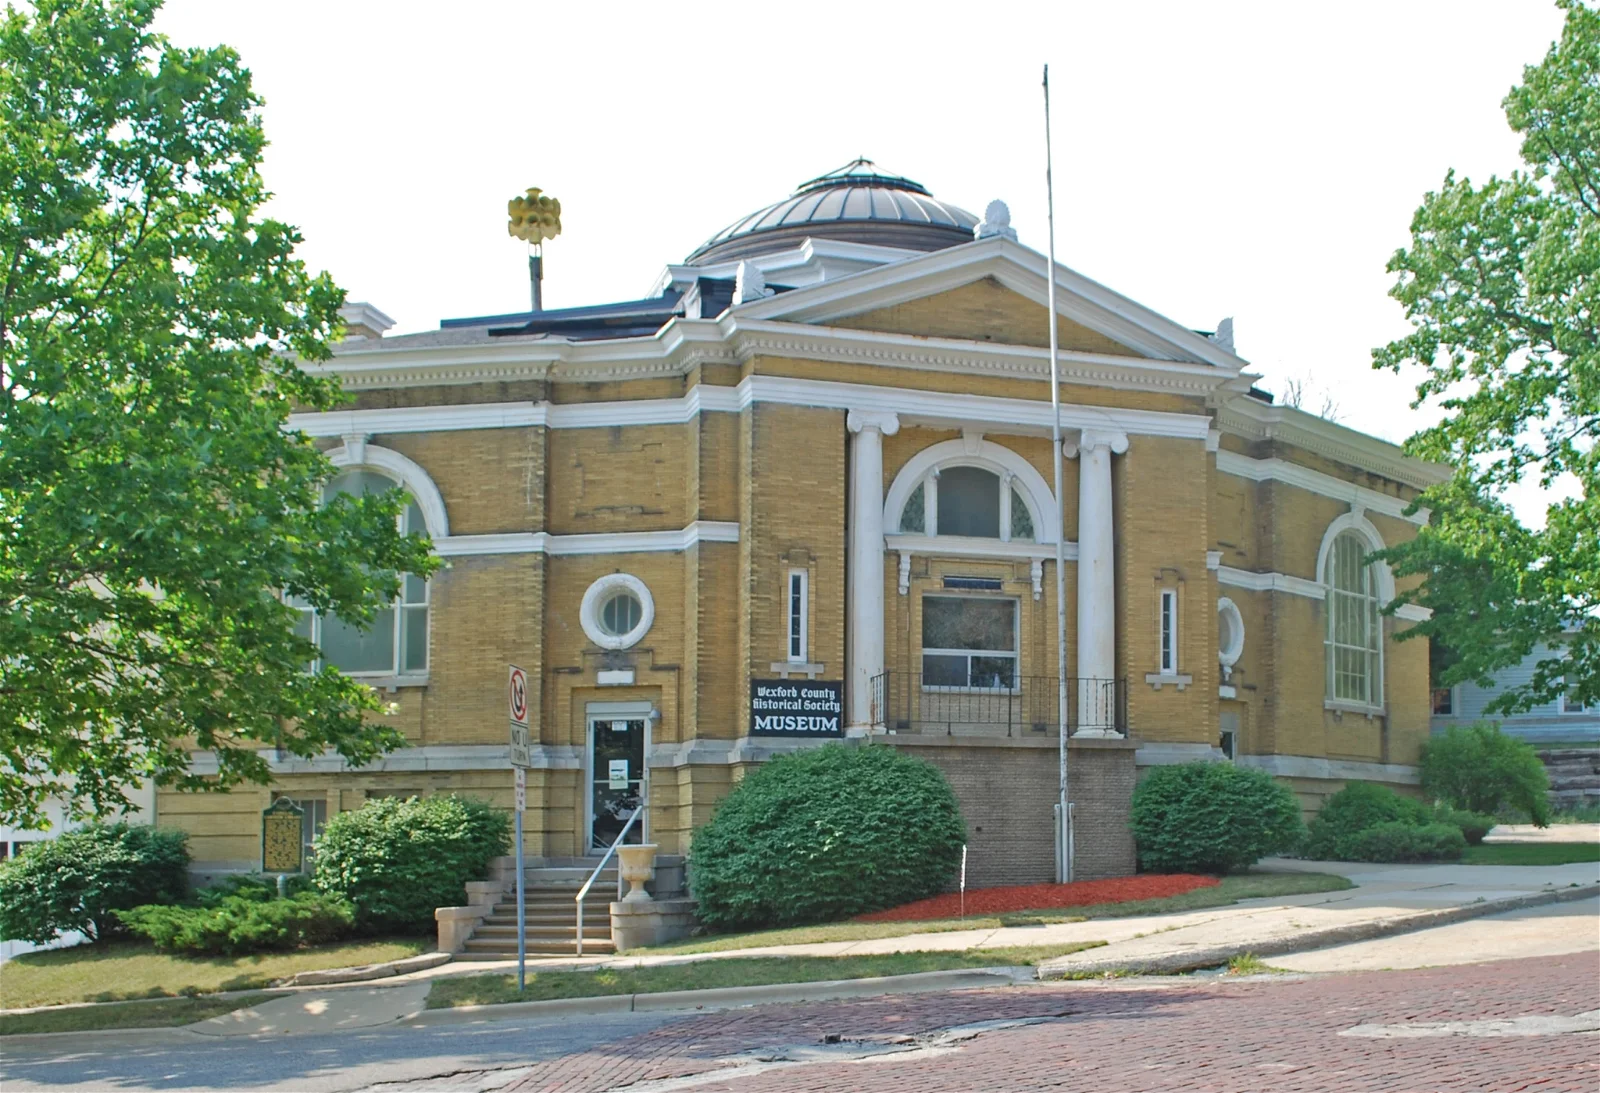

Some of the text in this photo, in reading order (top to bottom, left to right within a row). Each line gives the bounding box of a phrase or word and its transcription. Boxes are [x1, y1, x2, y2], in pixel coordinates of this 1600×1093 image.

[757, 686, 836, 701] Wexford County
[752, 698, 841, 713] Historical Society
[754, 715, 838, 731] MUSEUM
[512, 730, 527, 747] NO U
